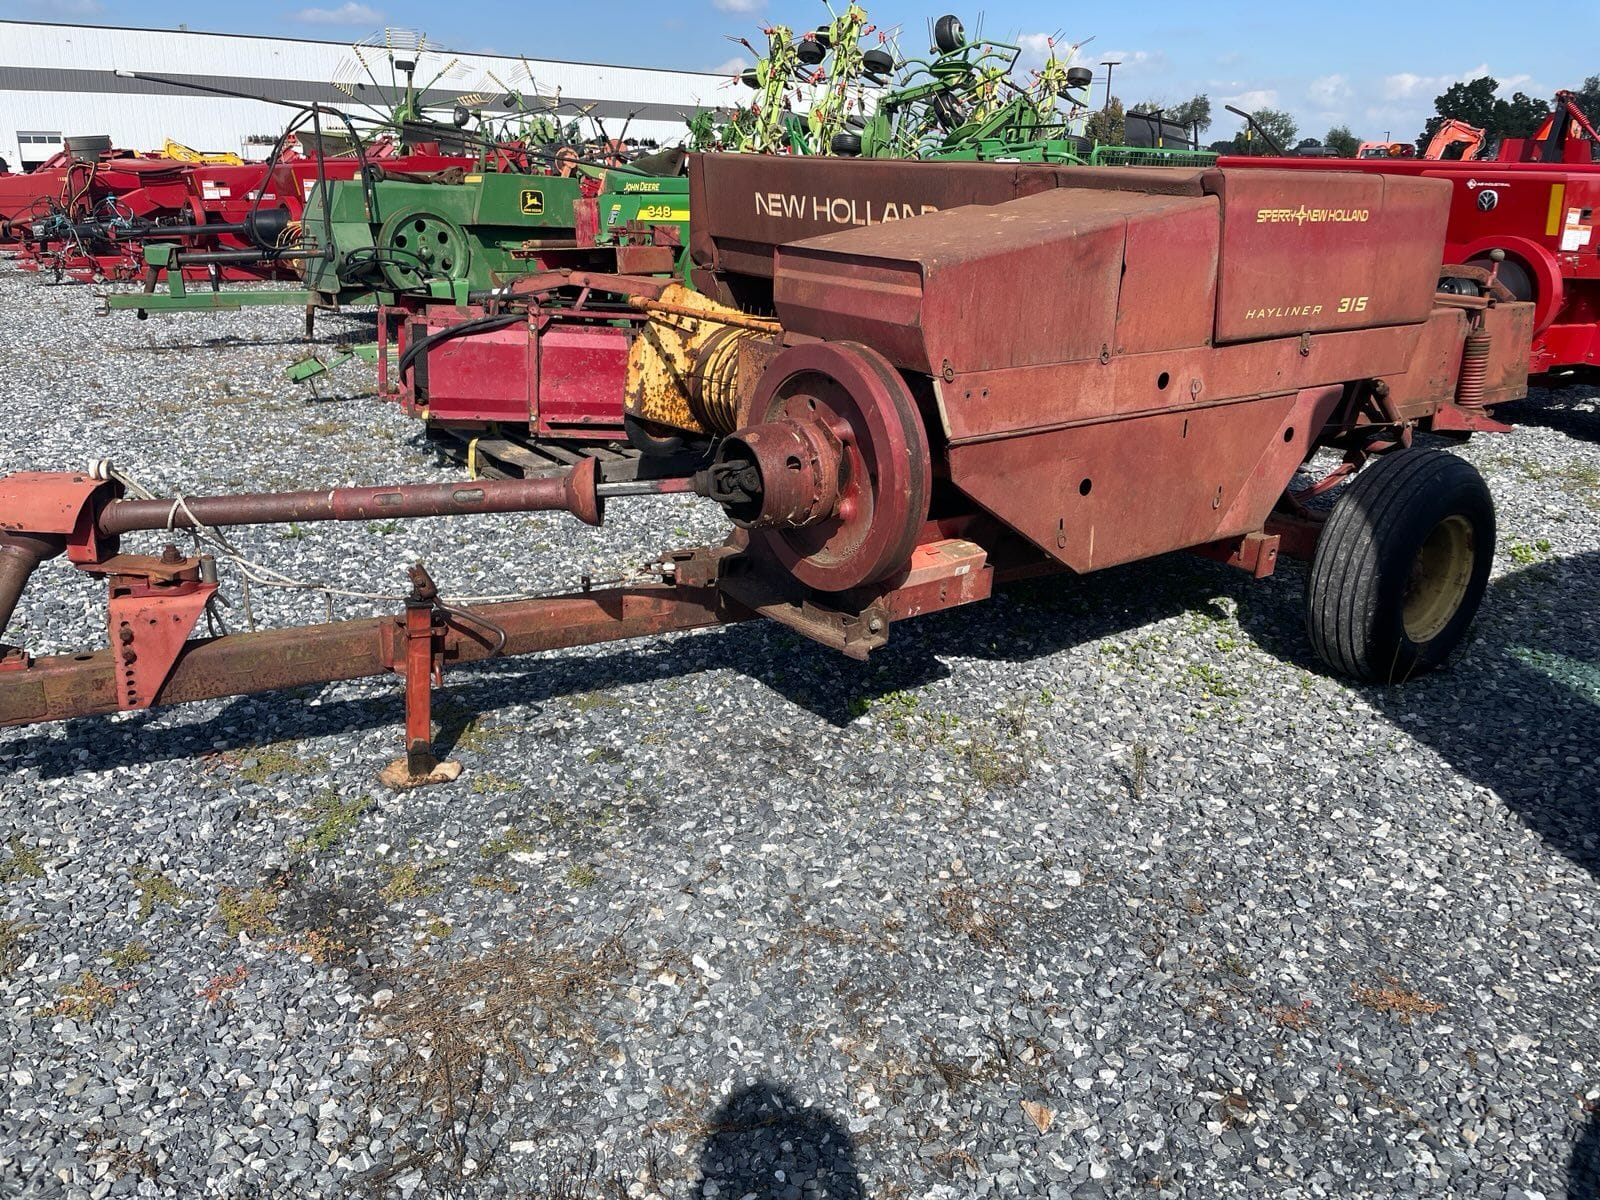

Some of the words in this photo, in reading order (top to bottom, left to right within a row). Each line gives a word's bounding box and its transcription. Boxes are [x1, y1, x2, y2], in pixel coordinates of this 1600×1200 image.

[624, 182, 640, 191] JOHN
[640, 182, 660, 191] DEERE
[647, 205, 672, 217] 348
[755, 192, 806, 219] NEW
[1257, 209, 1297, 223] SPERRY
[1306, 209, 1329, 222] NEW
[1328, 209, 1369, 222] HOLLAND
[1245, 305, 1323, 320] HAYLINER
[1337, 296, 1369, 313] 315
